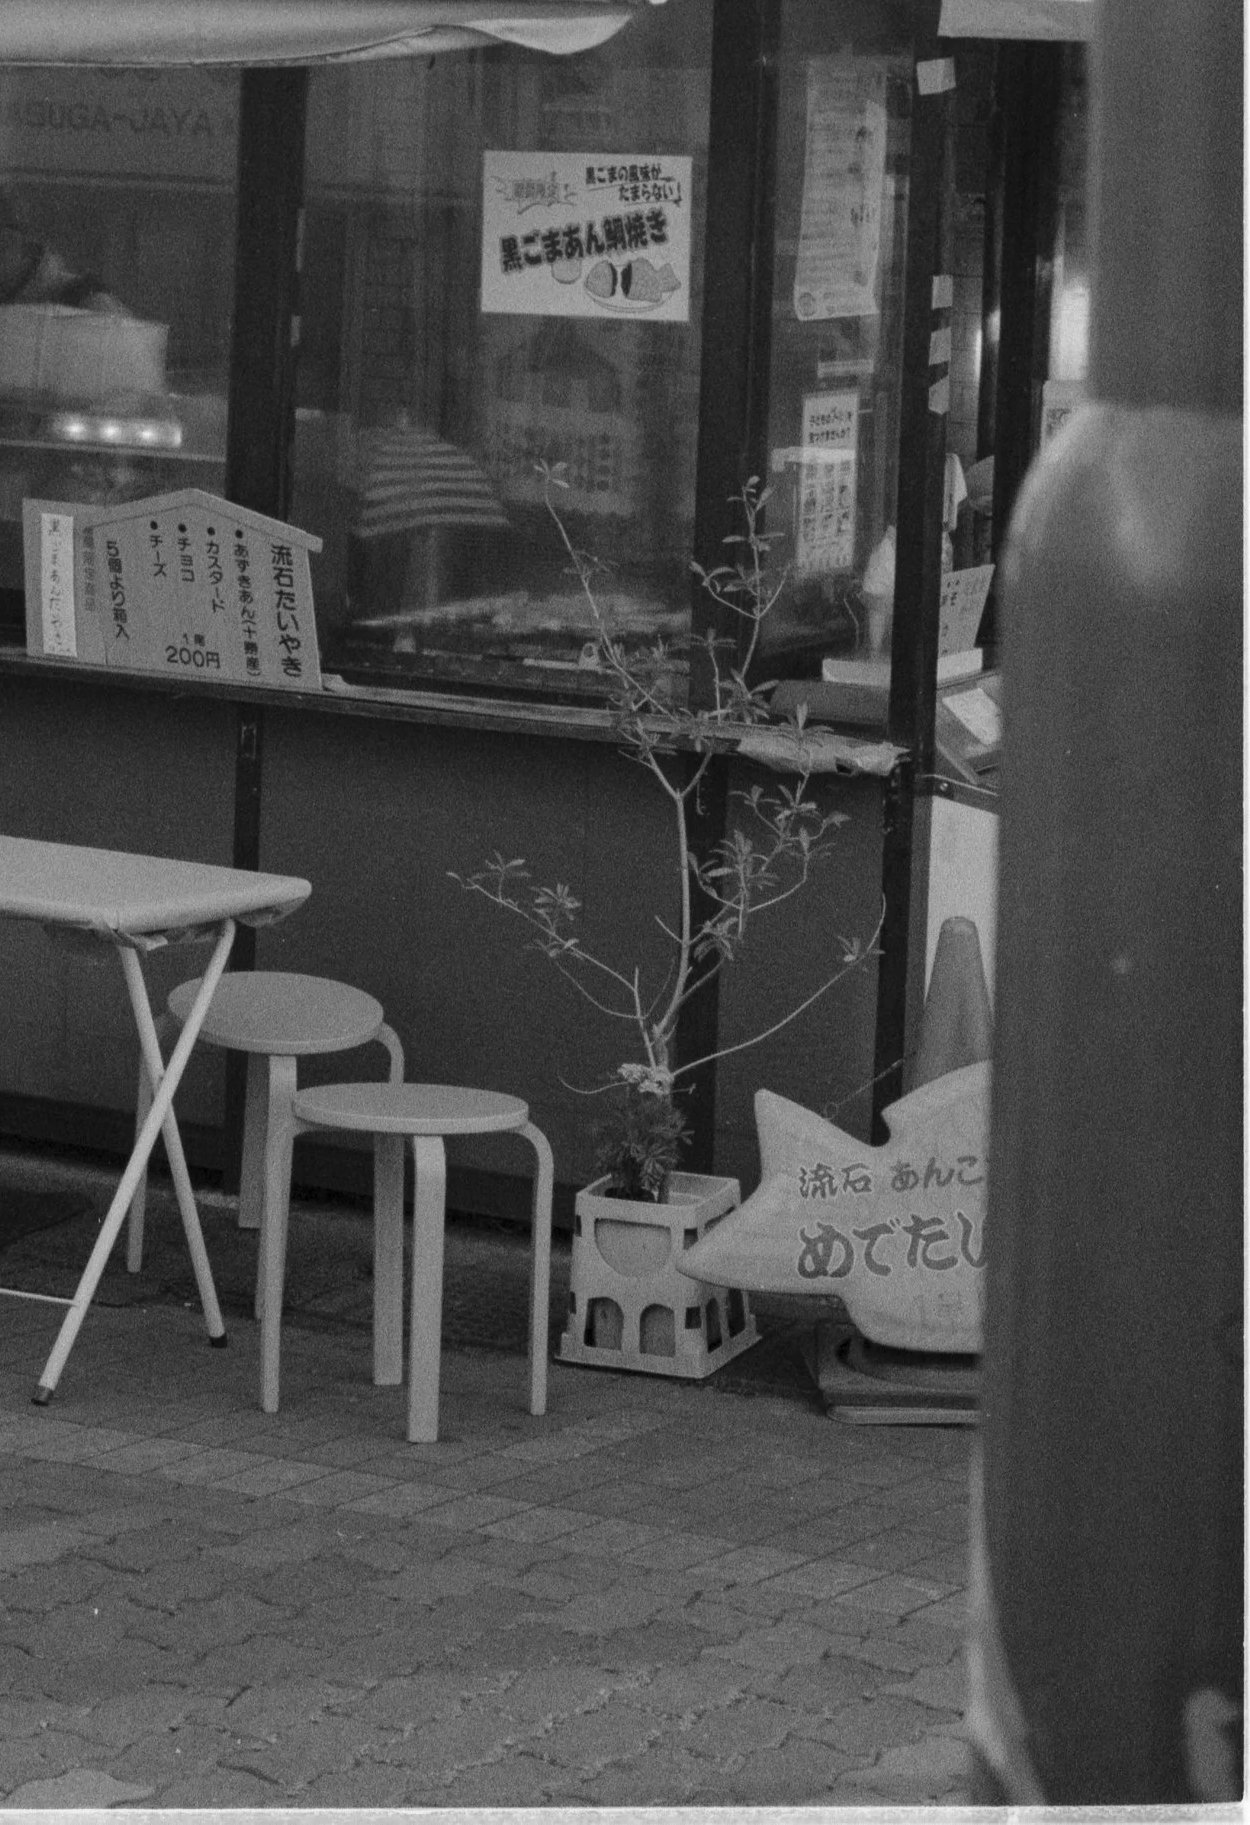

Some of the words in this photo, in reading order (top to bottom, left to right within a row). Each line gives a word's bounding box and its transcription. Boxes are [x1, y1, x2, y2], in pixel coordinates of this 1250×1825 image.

[500, 206, 669, 274] 黒ごまあん鯛焼き
[205, 541, 227, 614] カスタード
[270, 543, 303, 678] 流石たいやき
[164, 645, 222, 670] 200円
[799, 1161, 874, 1200] 流石
